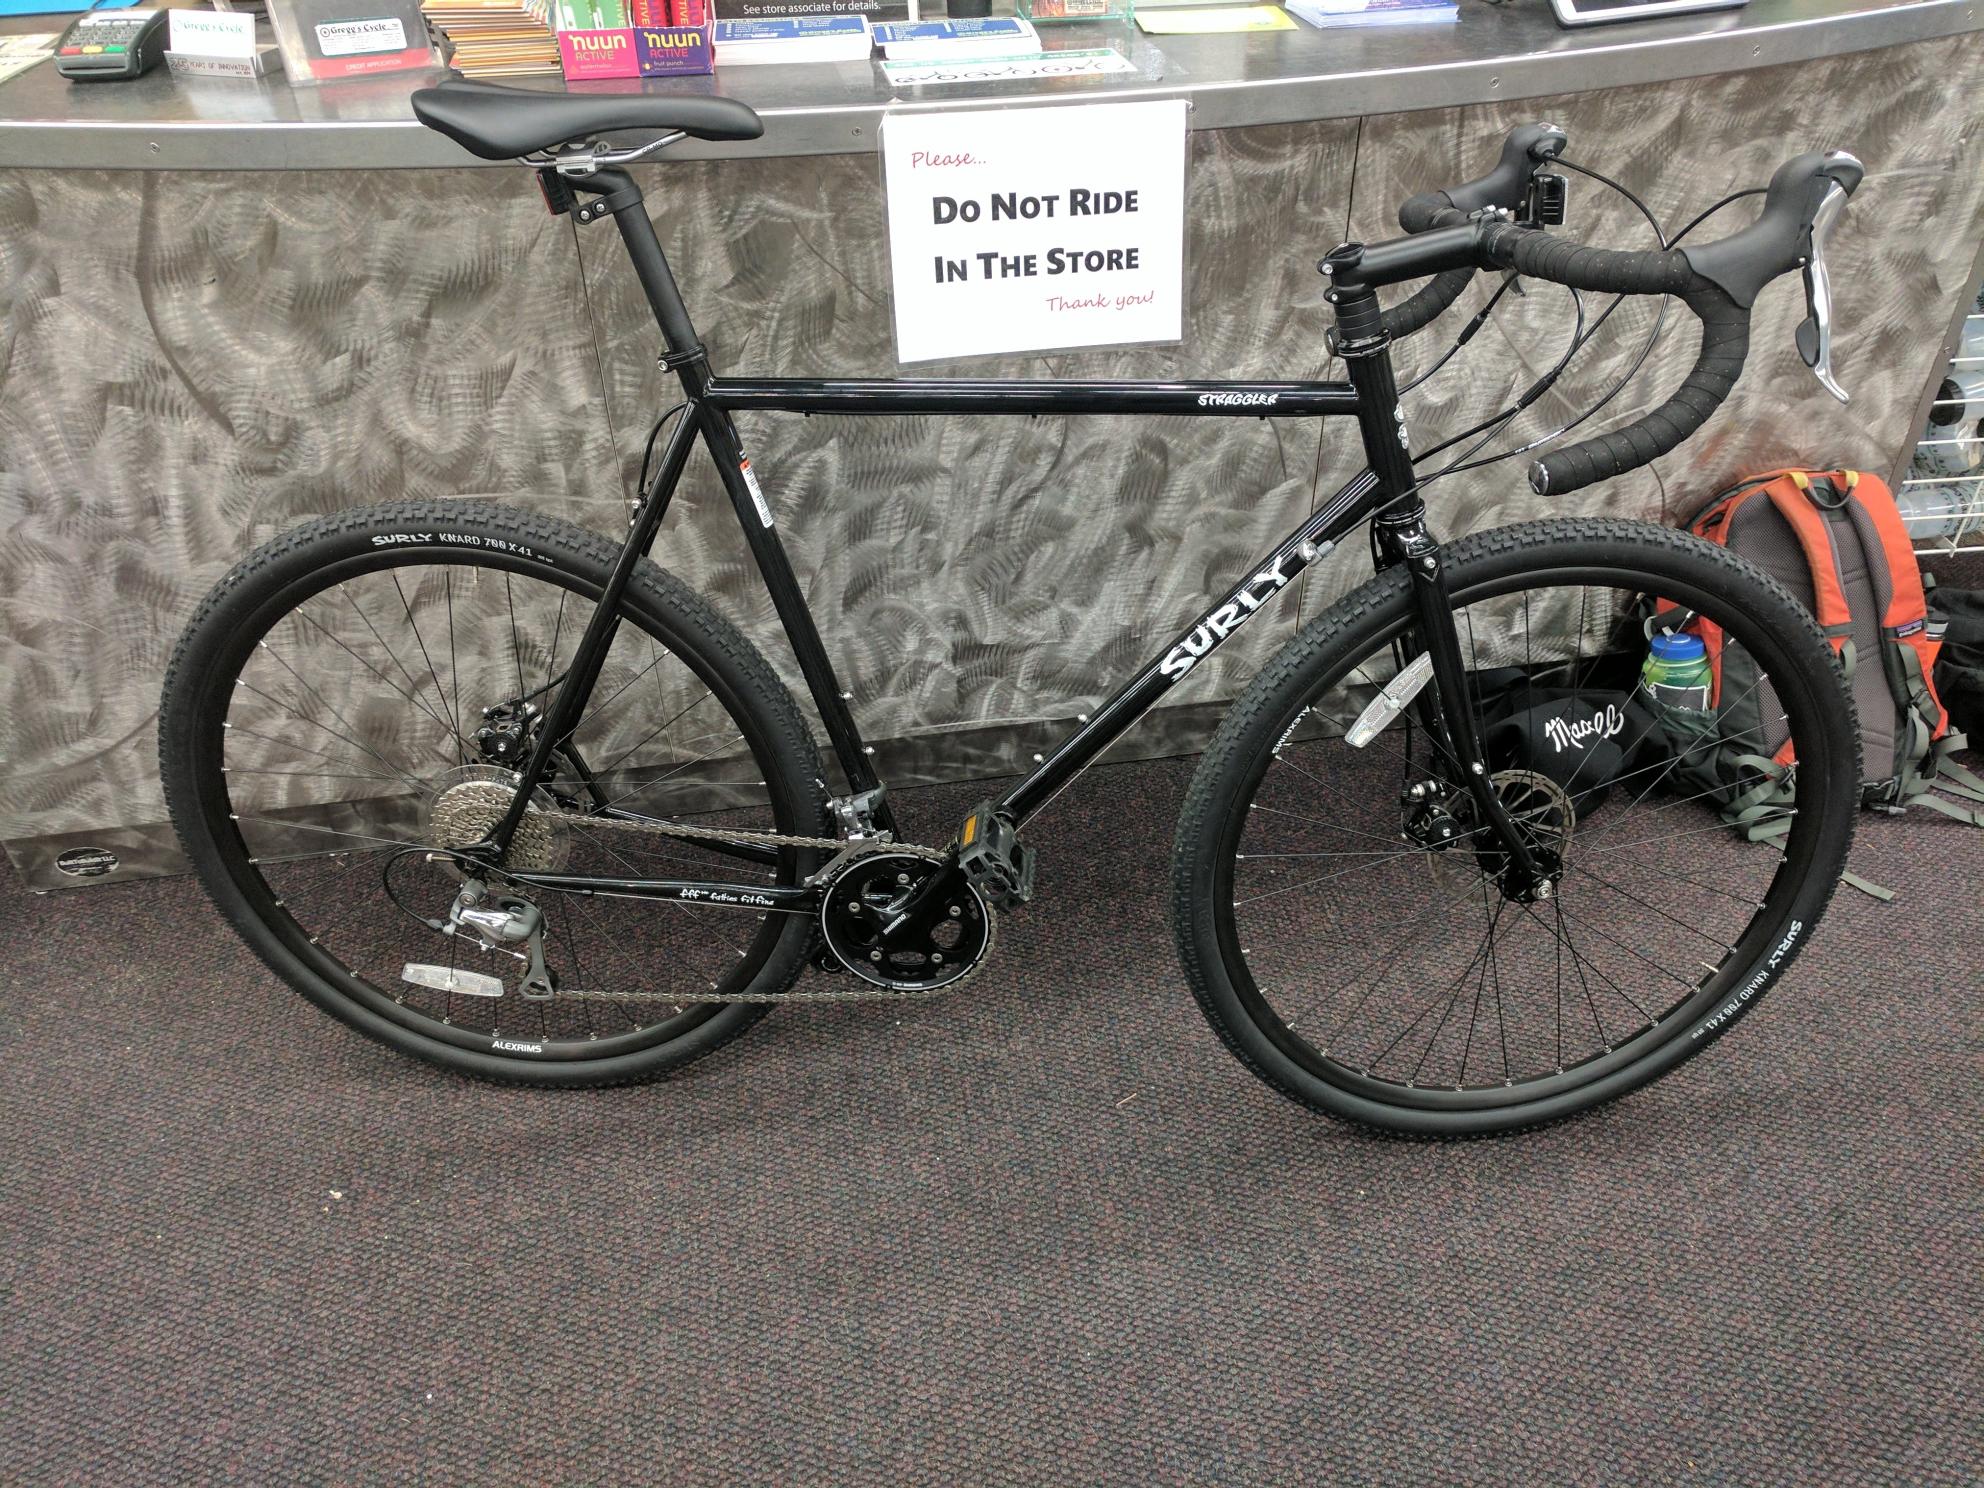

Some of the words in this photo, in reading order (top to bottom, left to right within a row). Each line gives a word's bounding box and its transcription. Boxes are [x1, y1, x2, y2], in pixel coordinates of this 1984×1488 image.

[616, 0, 626, 27] TIVE
[639, 0, 651, 25] TIVE
[679, 0, 689, 25] TIVE
[743, 4, 760, 15] See
[762, 4, 786, 13] store
[788, 2, 830, 13] associate
[832, 1, 846, 11] for
[848, 0, 881, 10] details.
[330, 24, 361, 35] Gregg's
[363, 23, 387, 32] Cycle
[568, 34, 627, 51] nuun
[643, 31, 701, 48] nuun
[576, 51, 615, 61] ACTIVE
[650, 48, 689, 59] ACTIVE
[345, 62, 366, 71] CREDIT
[366, 58, 402, 68] APPLICATION
[666, 60, 684, 68] punch
[911, 151, 987, 168] Please...
[1046, 293, 1110, 311] Thank
[1116, 290, 1155, 311] you!
[1197, 391, 1279, 406] STRAGGLER
[371, 533, 433, 546] SURLY
[439, 532, 481, 546] KNARD
[483, 537, 507, 550] 700
[517, 545, 533, 557] 41
[1160, 555, 1288, 682] SURLY
[1272, 705, 1310, 753] ALEXRIMS
[883, 913, 907, 935] SHIMANO
[1768, 920, 1802, 969] SURLY
[1739, 969, 1770, 1001] KNARD
[1723, 998, 1743, 1016] 700
[1705, 1018, 1718, 1030] 41
[491, 1040, 542, 1053] ALEXRIMS
